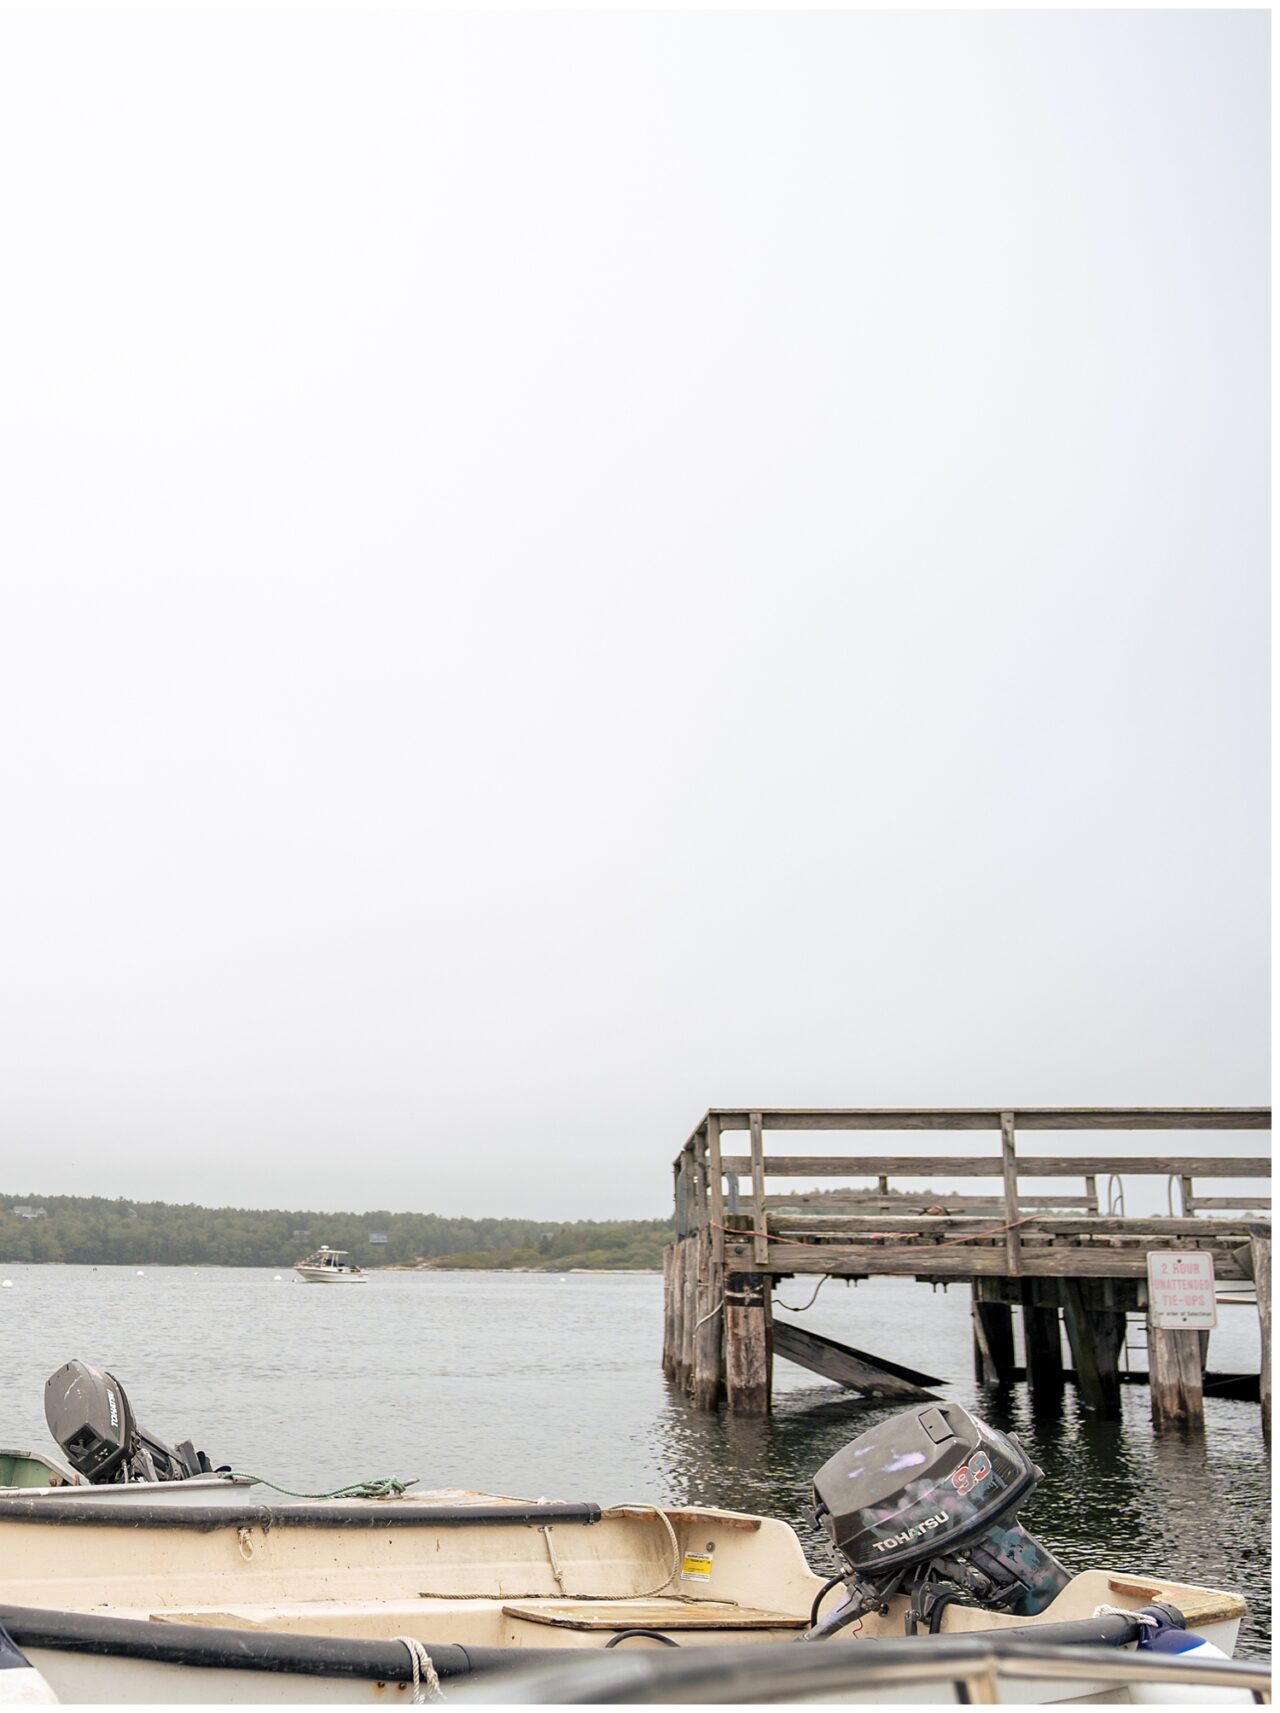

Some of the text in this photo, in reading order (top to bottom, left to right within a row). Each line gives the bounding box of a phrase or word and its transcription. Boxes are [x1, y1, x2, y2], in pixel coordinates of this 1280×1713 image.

[1161, 1263, 1200, 1274] 2 HOUR
[1154, 1280, 1210, 1290] UNATTENDED
[1163, 1295, 1205, 1306] TIE-UPS
[872, 1510, 950, 1552] TOHATSU
